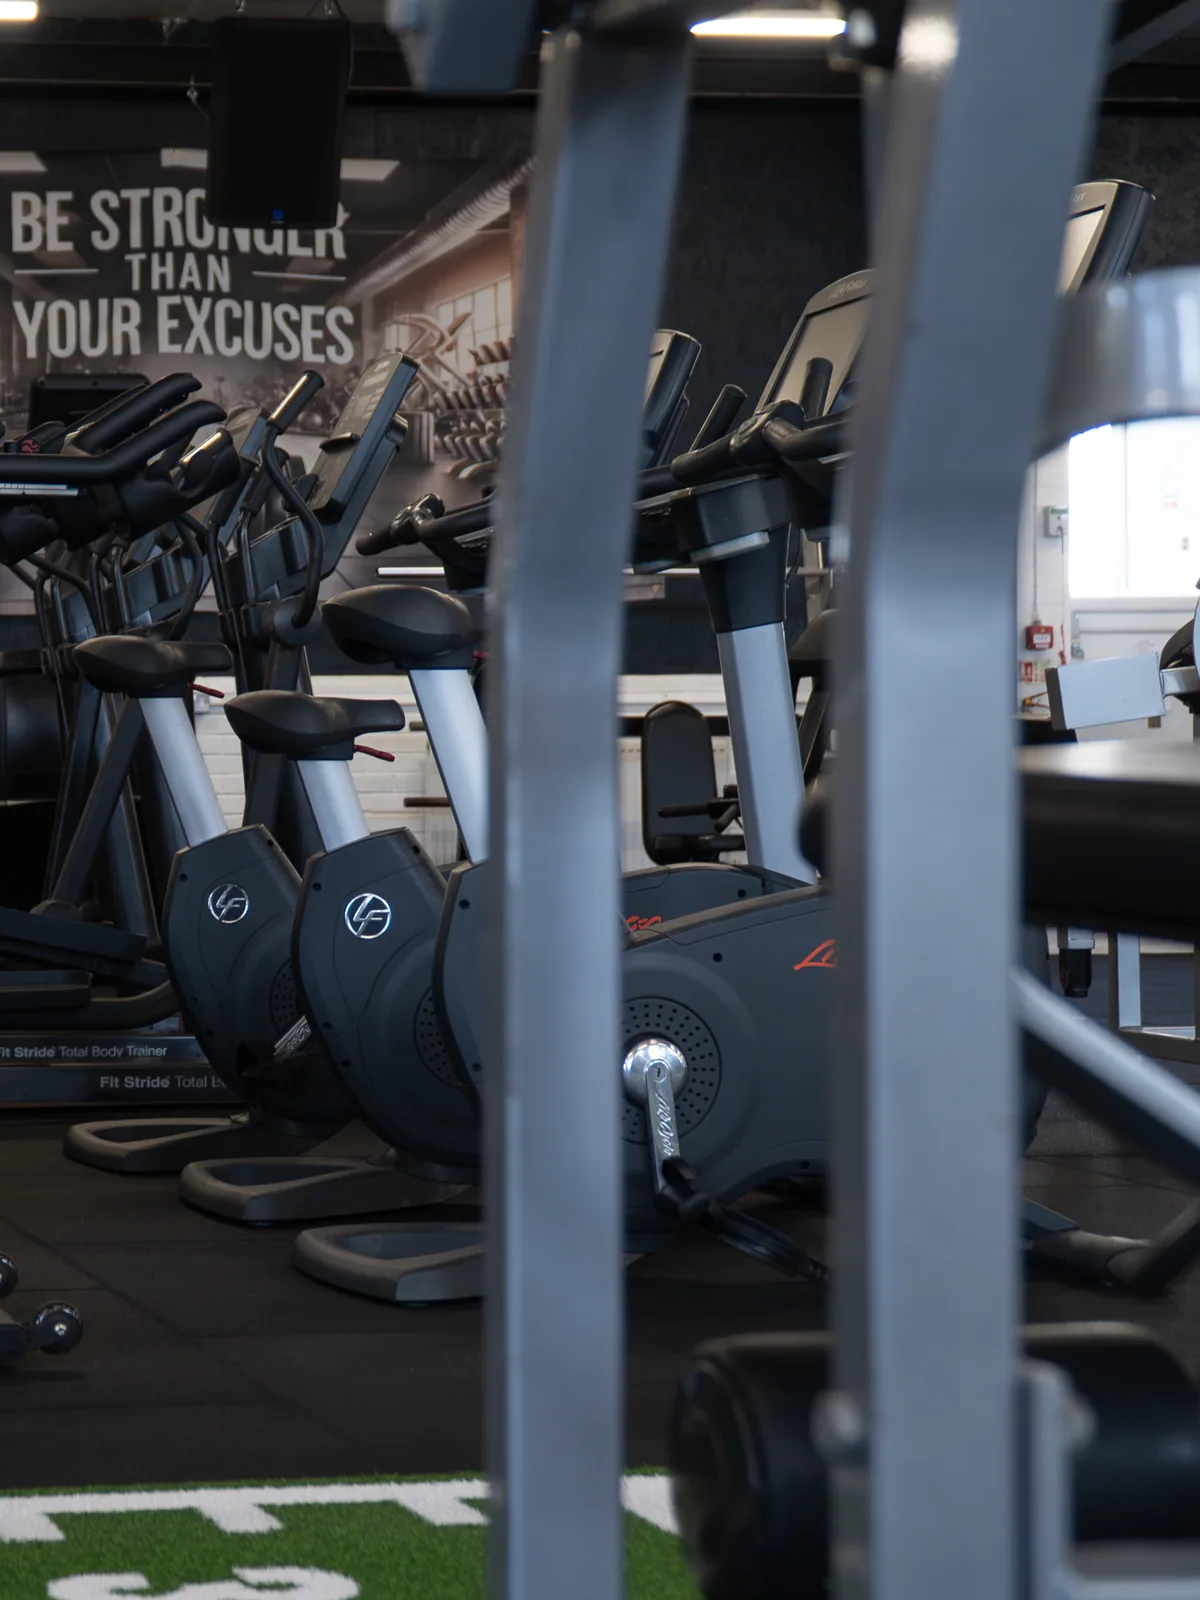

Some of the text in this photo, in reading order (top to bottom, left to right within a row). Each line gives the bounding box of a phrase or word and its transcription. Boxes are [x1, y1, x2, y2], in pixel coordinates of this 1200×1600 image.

[11, 190, 75, 254] BE
[125, 252, 231, 293] THAN
[13, 295, 355, 365] YOUR EXCUSES
[14, 1045, 54, 1058] Stride
[59, 1045, 88, 1058] Total
[92, 1045, 123, 1058] Body
[126, 1044, 167, 1057] Trainer
[100, 1076, 119, 1088] Fit
[124, 1075, 169, 1088] Stride
[175, 1075, 208, 1088] Total
